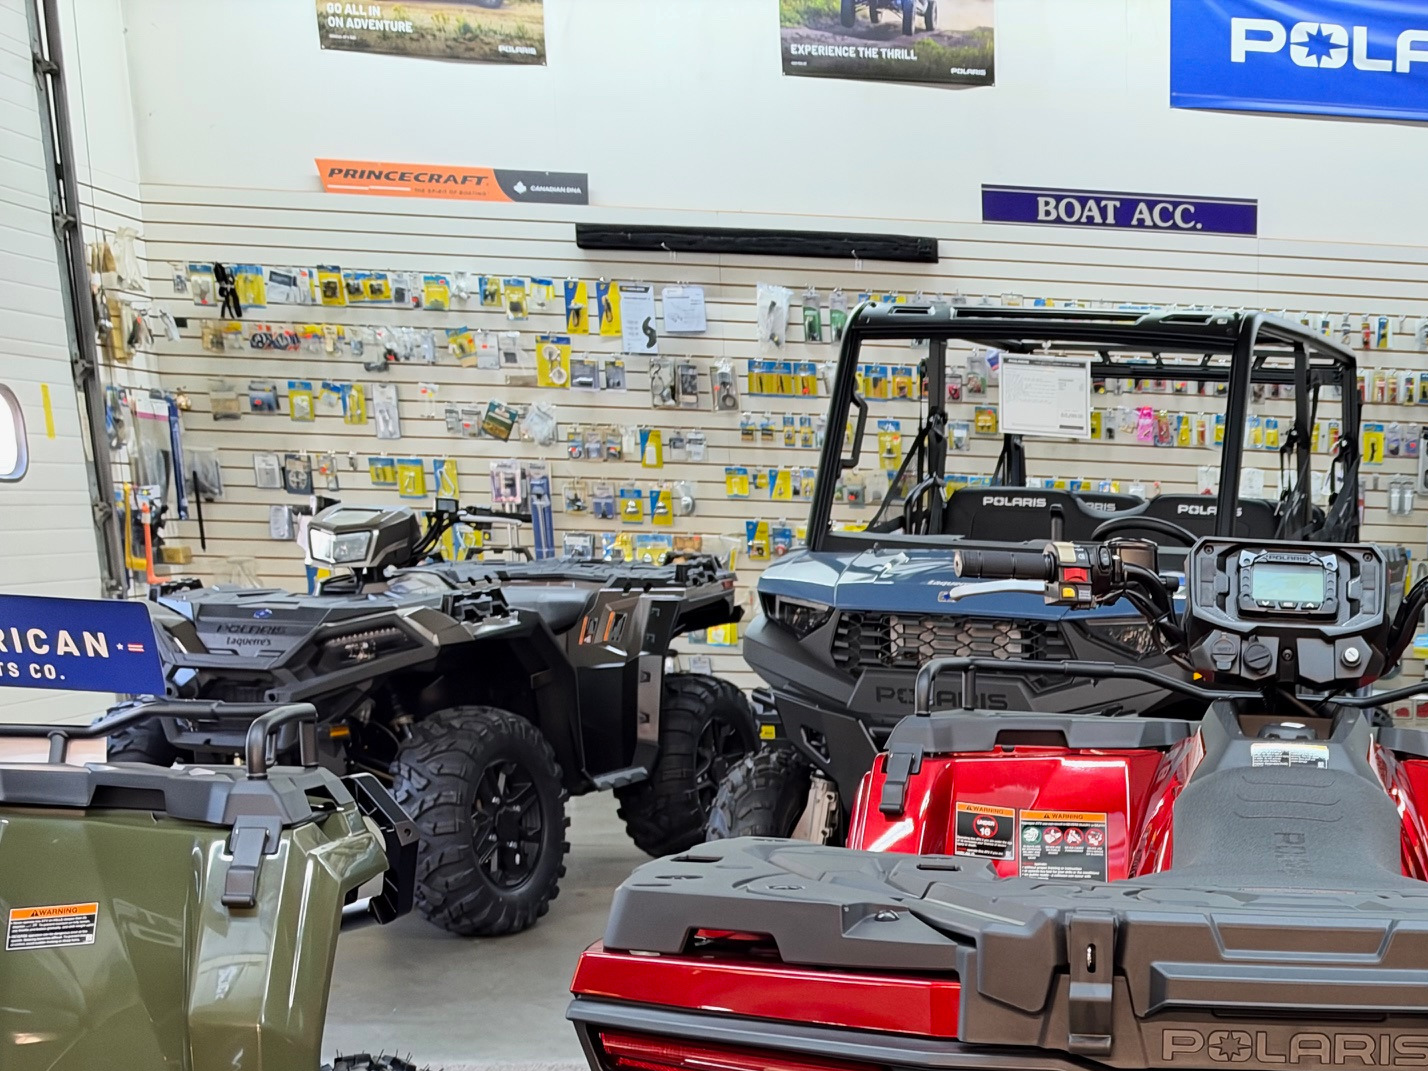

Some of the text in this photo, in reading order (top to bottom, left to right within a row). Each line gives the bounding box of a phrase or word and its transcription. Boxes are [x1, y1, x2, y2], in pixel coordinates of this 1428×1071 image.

[326, 3, 380, 17] GO ALL IN
[328, 16, 413, 33] ON ADVENTURE
[790, 44, 918, 61] EXPERIENCE THE THRILL
[950, 67, 986, 76] POLARIS
[328, 167, 488, 186] PRINCECRAFT
[1036, 196, 1203, 230] BOAT ACC.
[982, 496, 1047, 508] POLARIS
[1177, 504, 1242, 517] POLAS
[226, 636, 272, 647] Laquerre's
[29, 663, 66, 680] CO.
[974, 806, 1004, 814] WARNING
[1052, 812, 1084, 820] WARNING
[976, 819, 995, 828] UNDER
[980, 827, 990, 836] 16
[40, 907, 78, 916] WARNING
